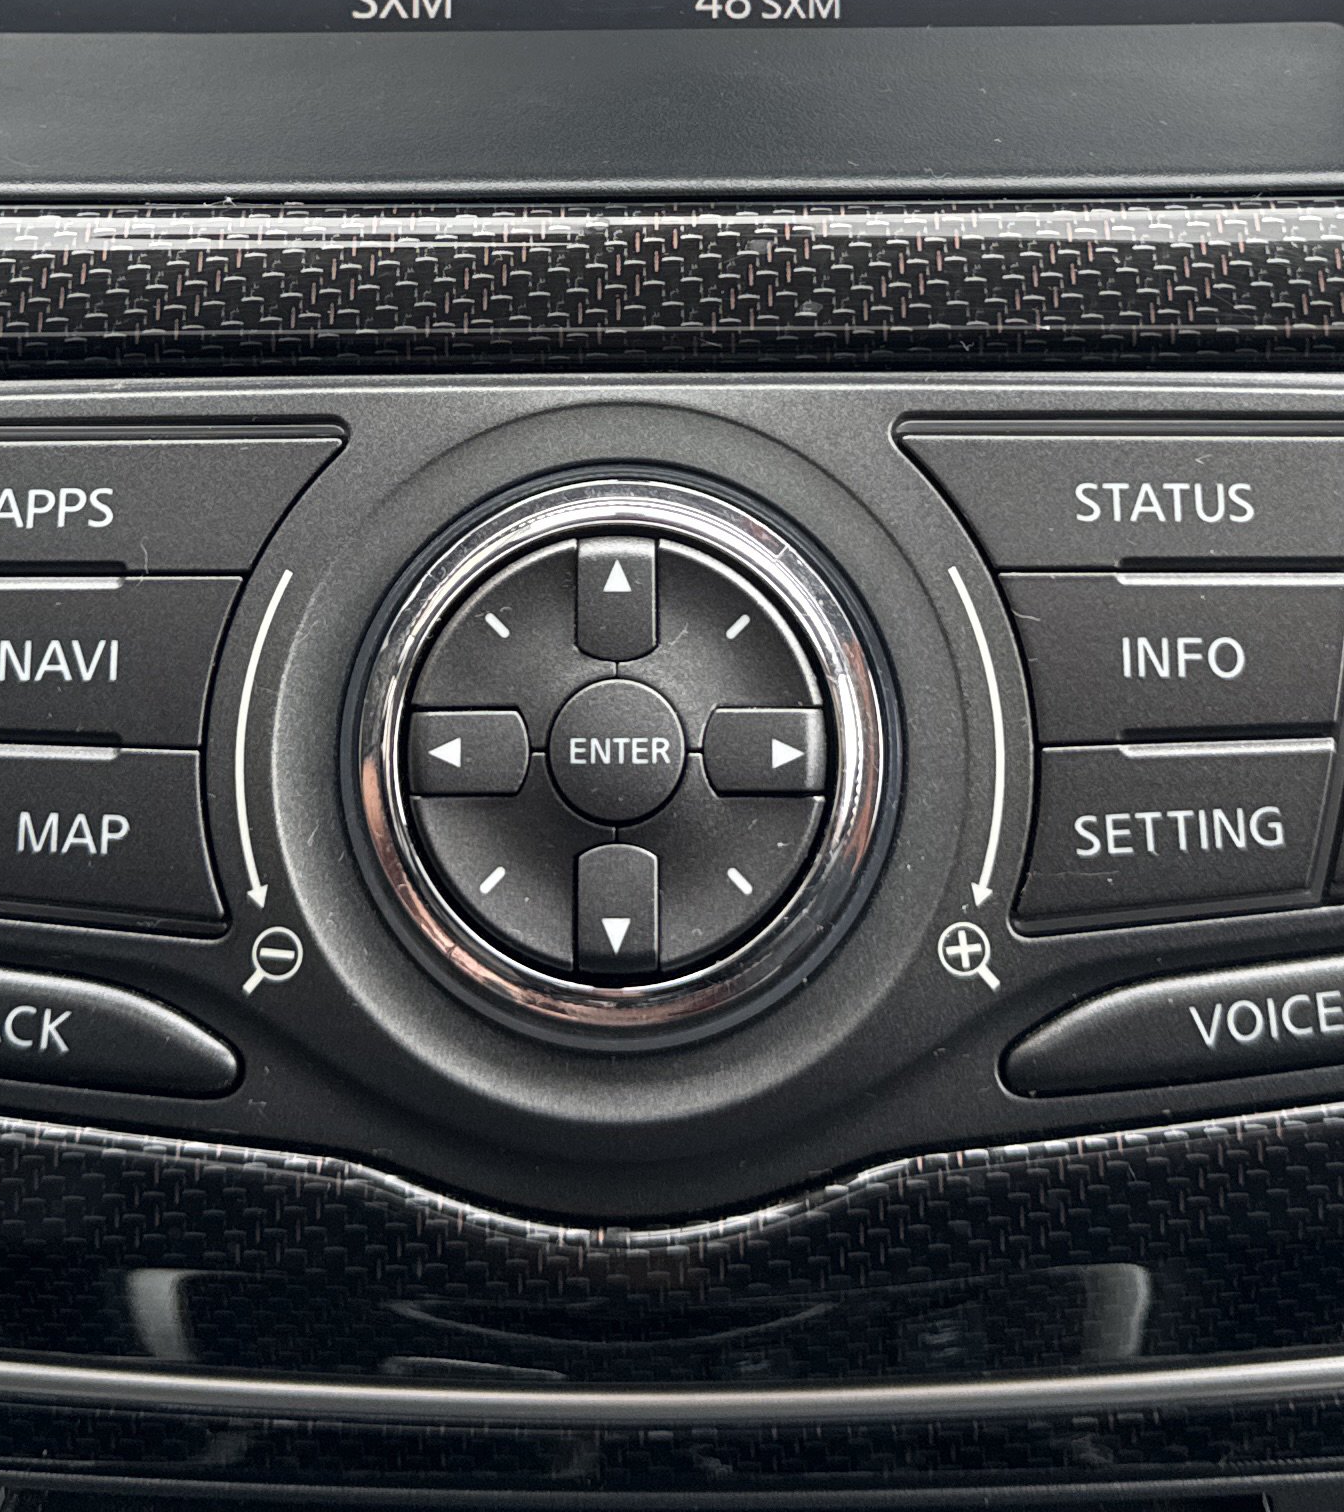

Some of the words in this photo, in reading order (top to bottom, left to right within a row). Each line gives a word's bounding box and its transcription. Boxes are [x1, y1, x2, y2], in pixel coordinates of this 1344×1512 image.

[1074, 482, 1256, 524] STATUS
[1121, 636, 1246, 679] INFO
[568, 737, 671, 766] ENTER
[16, 811, 130, 855] MAP
[1073, 806, 1286, 857] SETTING
